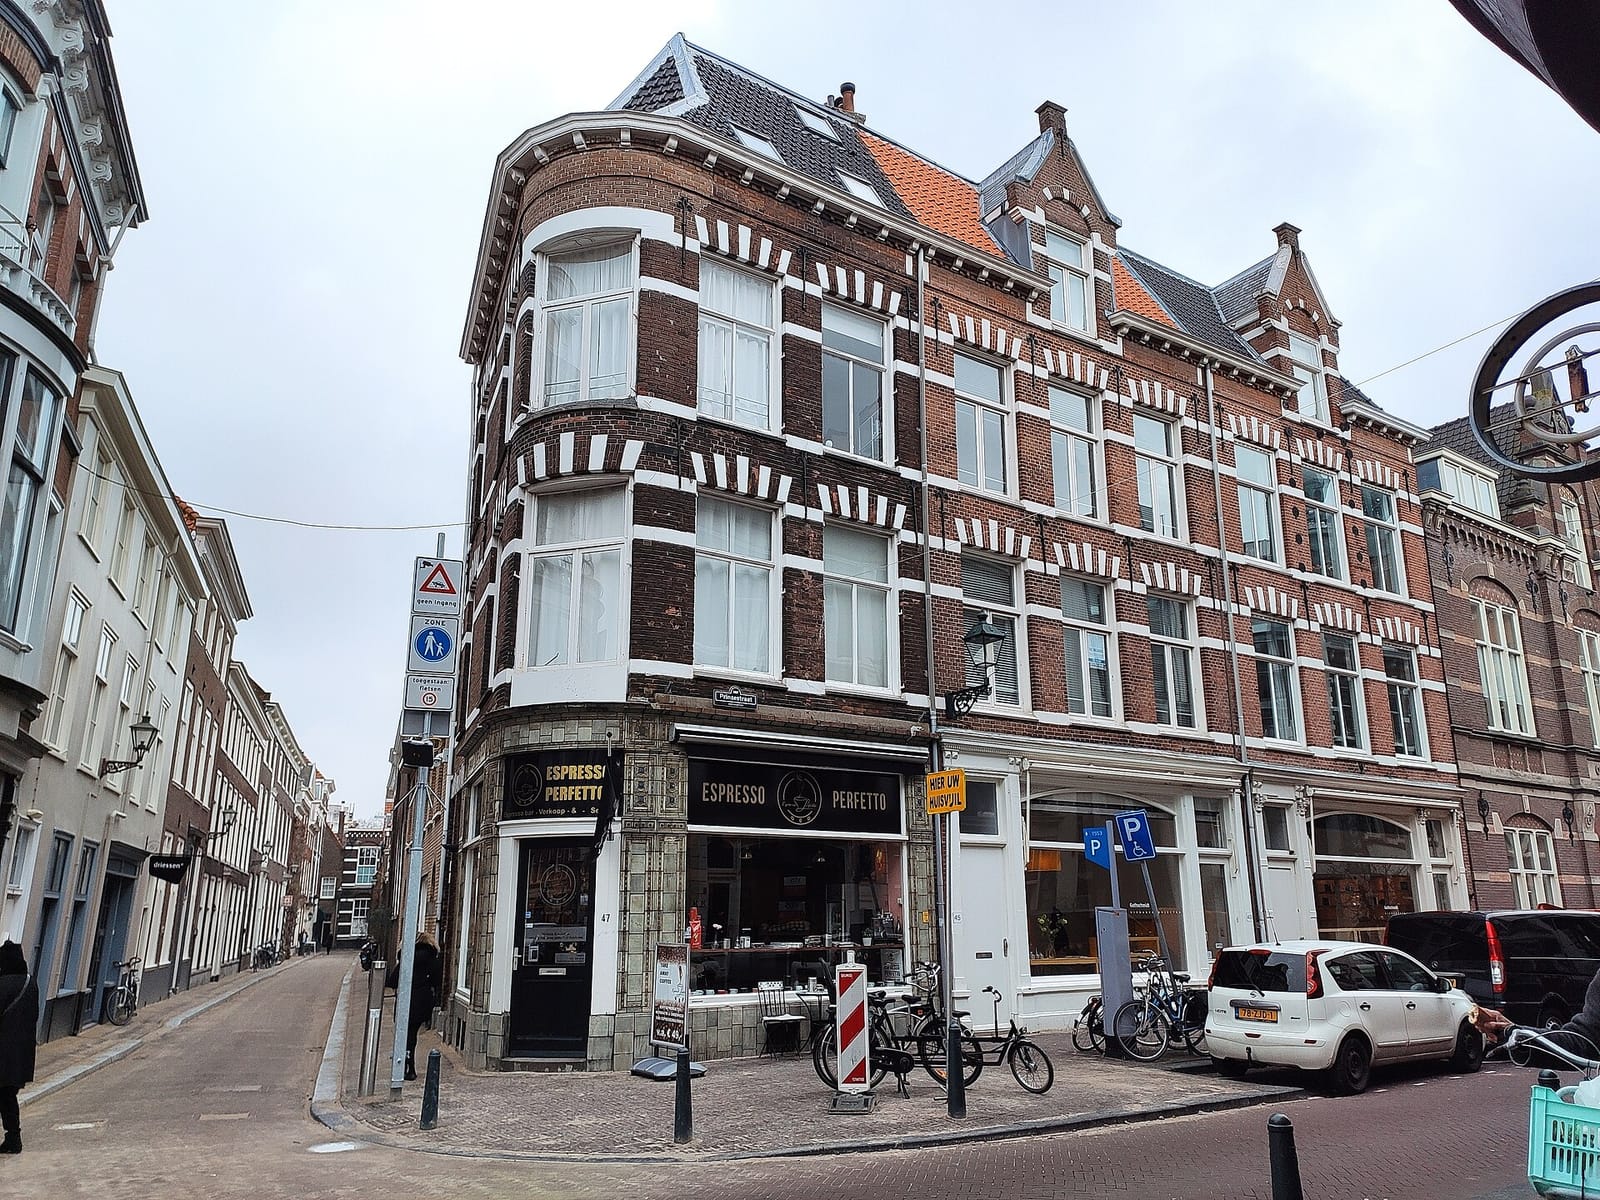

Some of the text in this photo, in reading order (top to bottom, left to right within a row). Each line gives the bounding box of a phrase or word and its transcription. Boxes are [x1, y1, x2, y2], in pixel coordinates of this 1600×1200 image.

[424, 618, 447, 627] ZONE
[929, 774, 960, 791] HIER UW
[702, 782, 887, 811] ESPRESSO PERFETTO
[1123, 818, 1141, 841] P
[1091, 840, 1101, 856] P
[601, 913, 611, 923] 47
[1241, 1008, 1275, 1020] 78-ZJD-1
